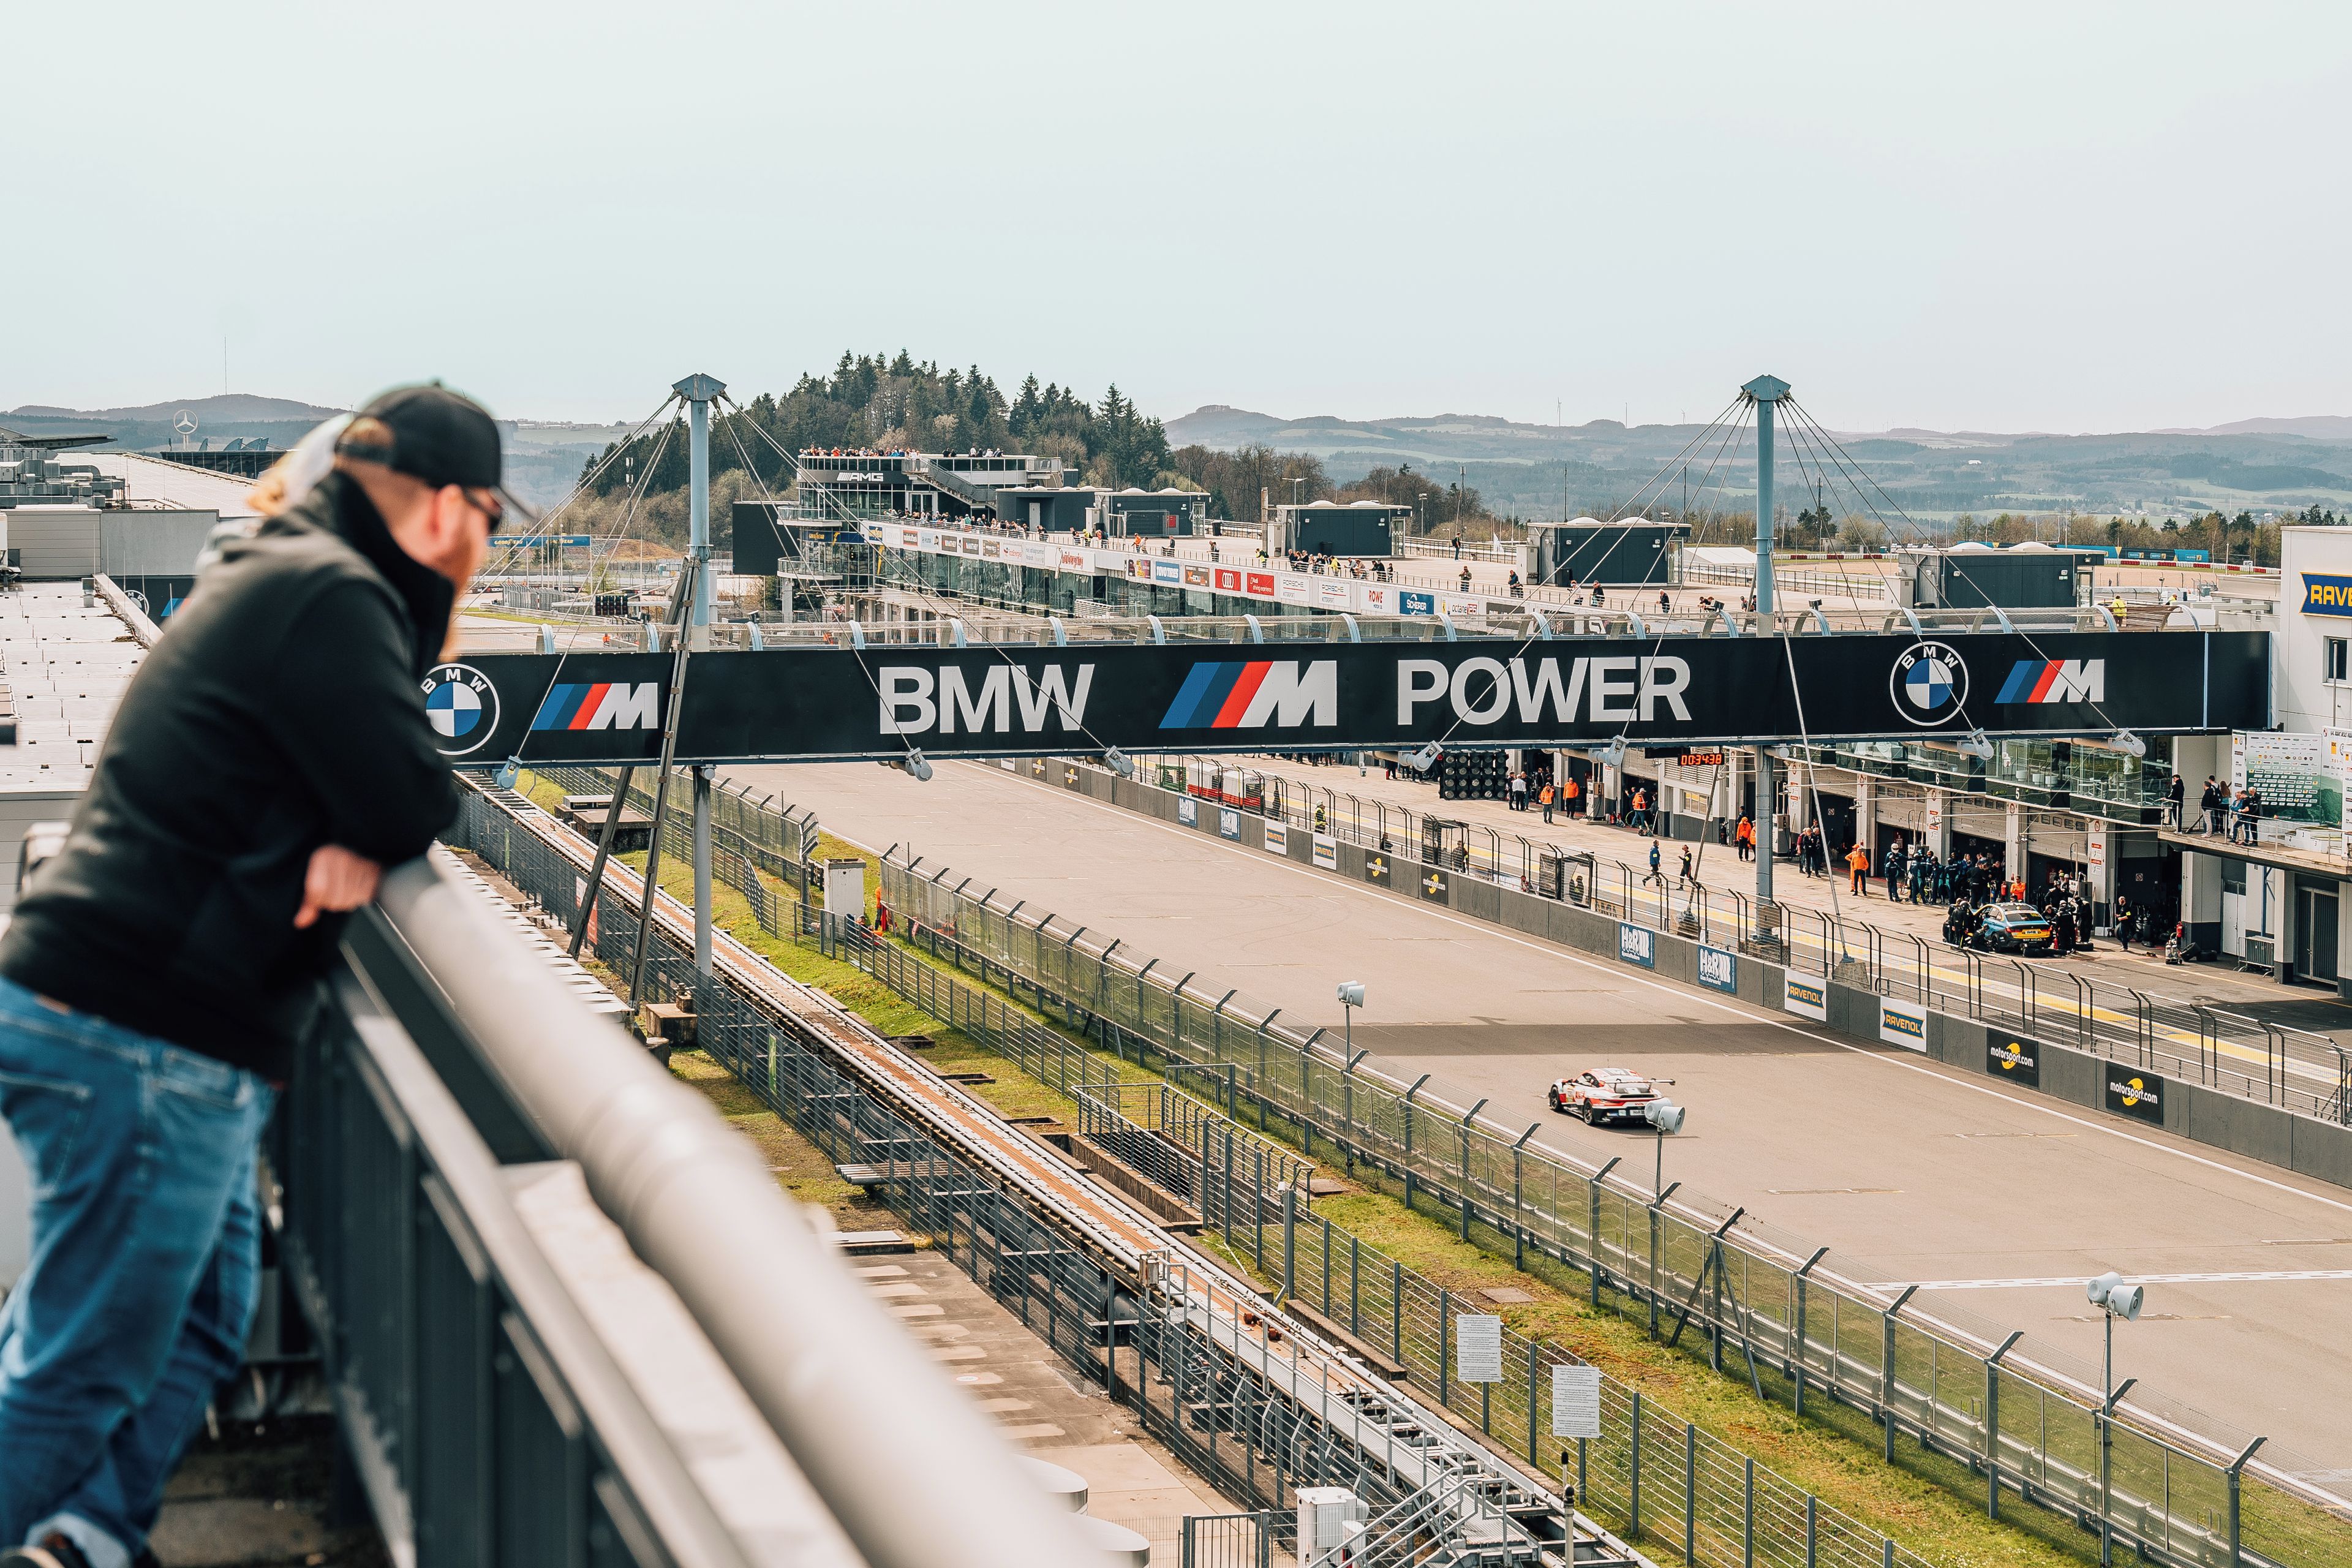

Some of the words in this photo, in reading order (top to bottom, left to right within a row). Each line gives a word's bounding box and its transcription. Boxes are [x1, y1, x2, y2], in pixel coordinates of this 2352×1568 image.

[850, 472, 884, 482] AMG
[1156, 566, 1167, 577] TOYO
[1167, 568, 1179, 579] TIRES
[1283, 579, 1304, 588] PORSCHE
[1322, 584, 1344, 593] PORSCHE
[127, 592, 145, 602] MW
[1368, 590, 1383, 604] ROWE
[1406, 598, 1427, 611] SCHERER
[1901, 646, 1959, 671] BMW
[420, 668, 488, 695] BMW
[1397, 655, 1692, 726] POWER
[880, 663, 1095, 735] BMW
[1793, 747, 1797, 758] 8
[1680, 753, 1722, 766] 00:34:38
[1861, 760, 1866, 771] 7
[1936, 773, 1940, 785] 6
[2015, 788, 2020, 800] 5
[2102, 804, 2107, 816] 4
[1315, 845, 1334, 858] RAVENOL
[1423, 878, 1446, 891] motorsport.com
[1700, 948, 1721, 981] H&R
[1790, 985, 1822, 1004] RAVENOL
[1886, 1014, 1921, 1034] RAVENOL
[1990, 1046, 2034, 1068] motorsport.com
[2109, 1080, 2158, 1105] motorsport.com
